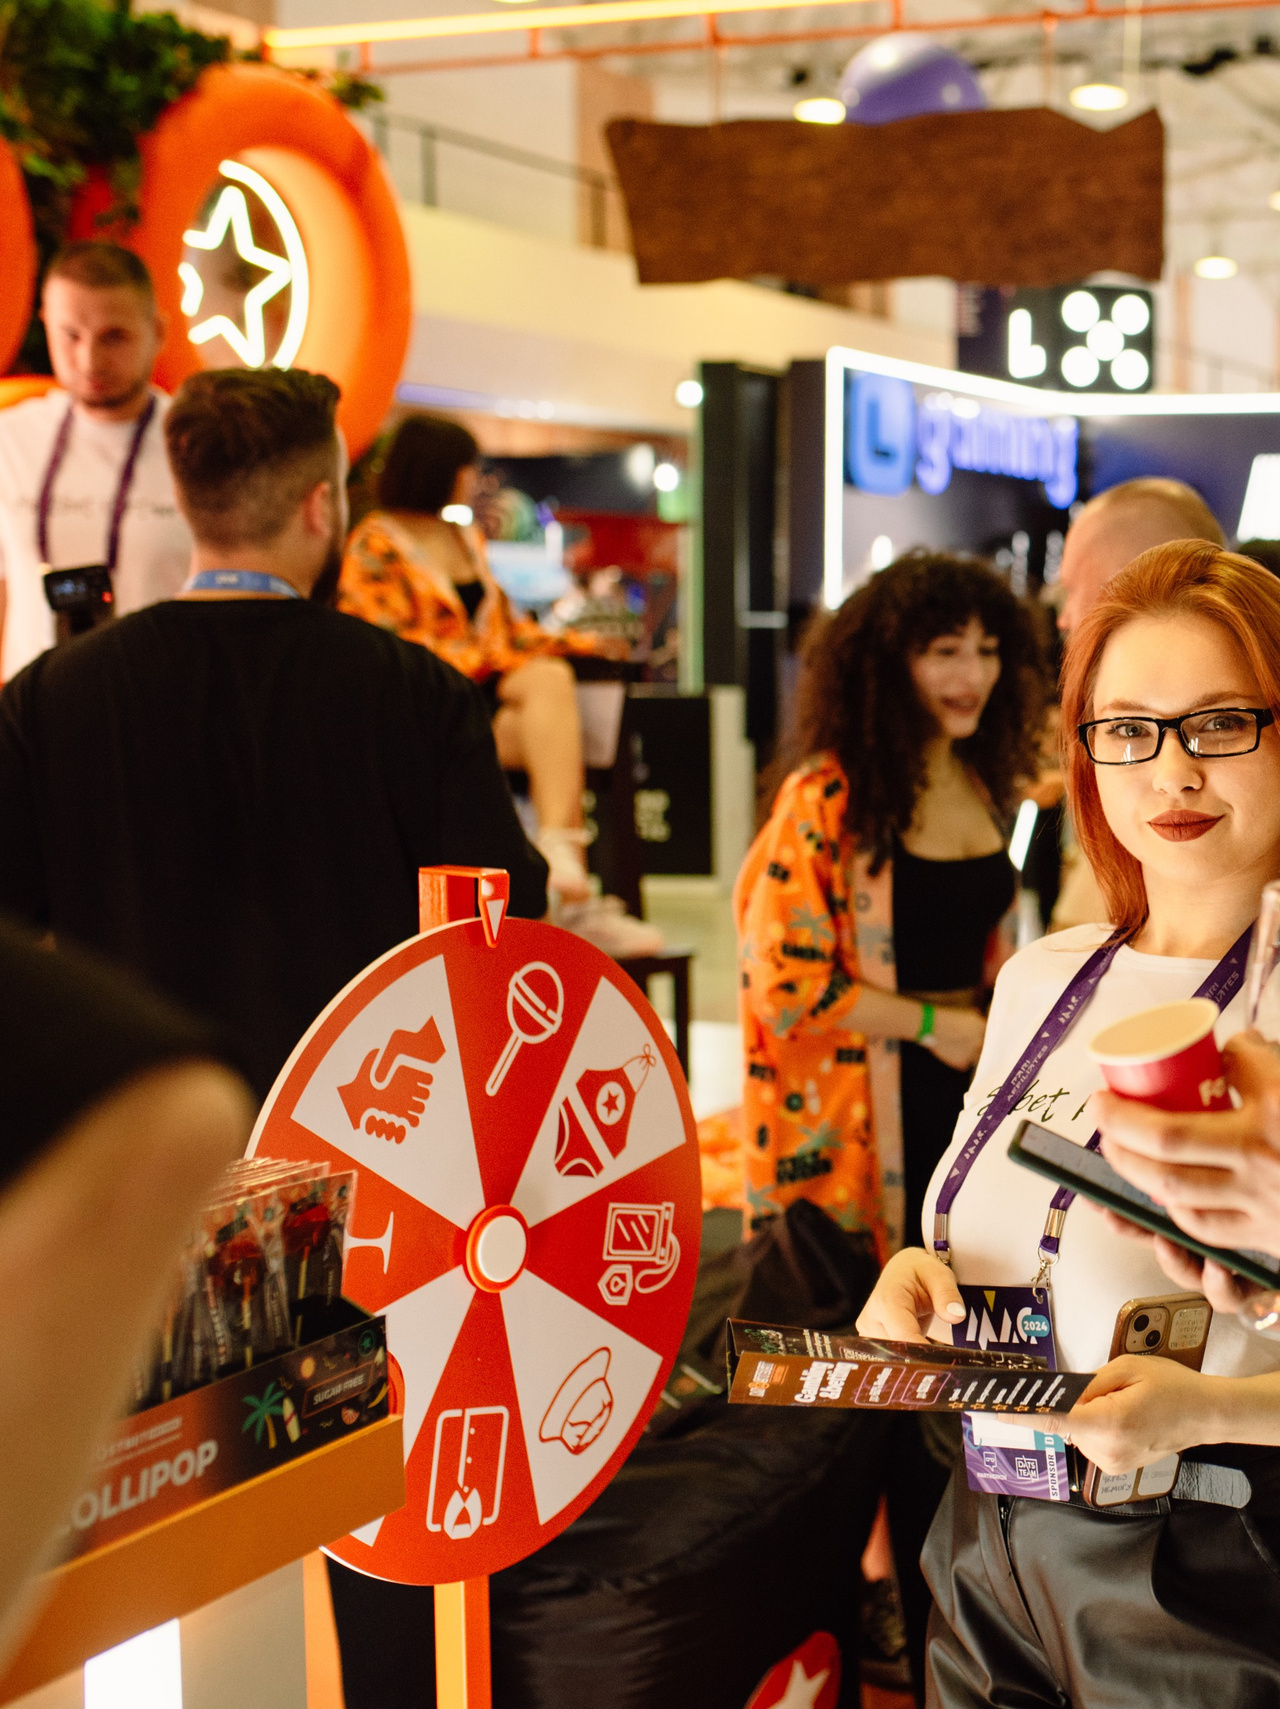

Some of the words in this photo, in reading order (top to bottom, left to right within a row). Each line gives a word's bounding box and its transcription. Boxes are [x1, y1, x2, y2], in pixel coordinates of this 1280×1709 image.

[1007, 1045, 1049, 1102] AFFILIATES
[1023, 1320, 1048, 1332] 2024
[56, 1440, 219, 1534] OLLIPOP
[1047, 1453, 1059, 1497] SPONSOR
